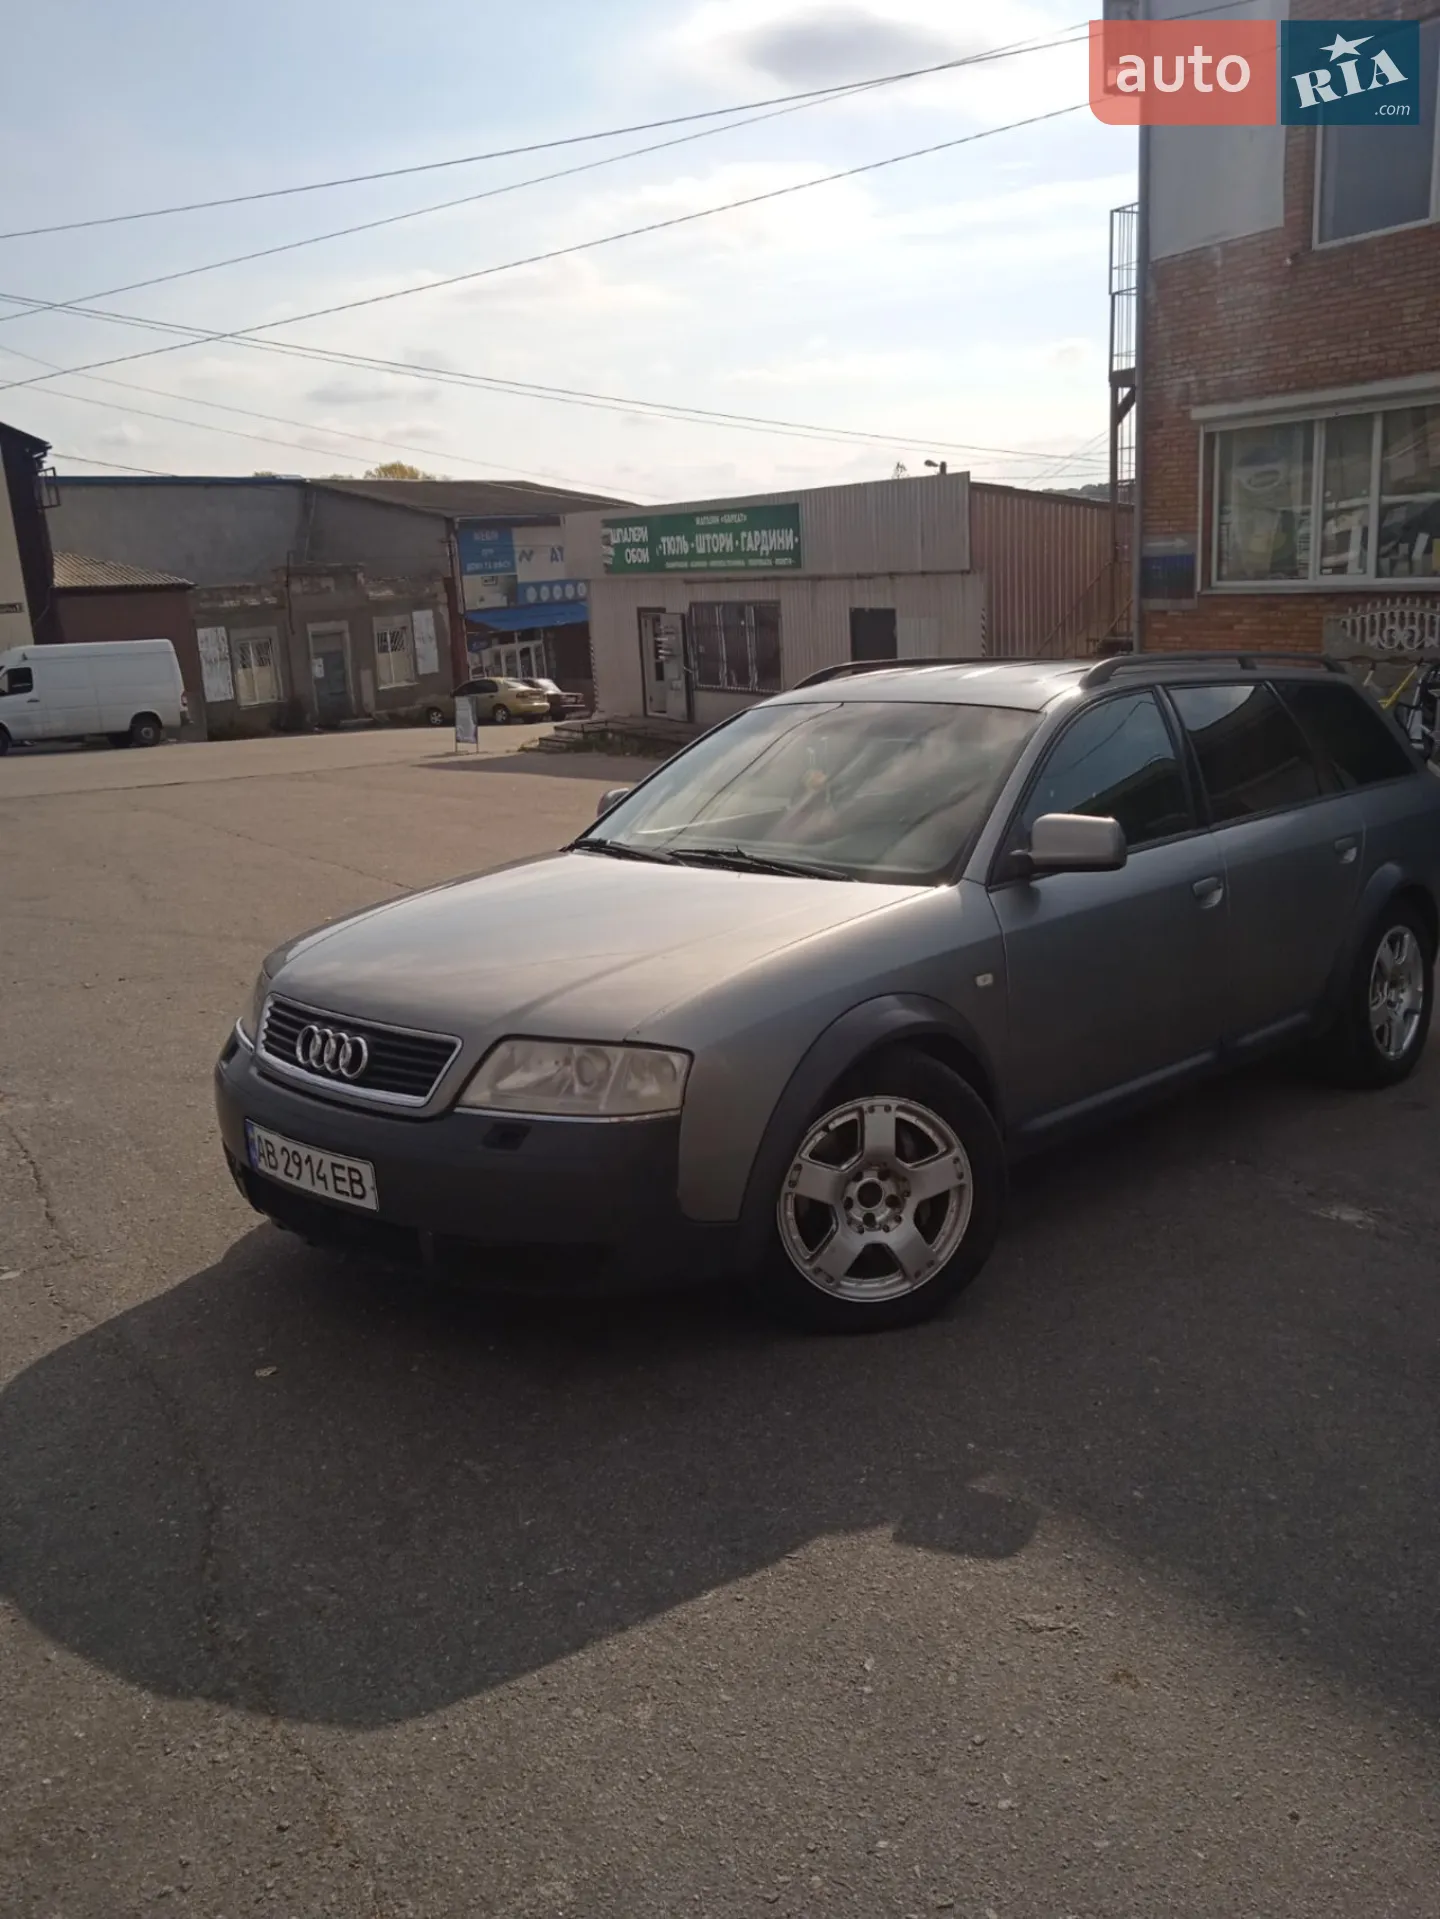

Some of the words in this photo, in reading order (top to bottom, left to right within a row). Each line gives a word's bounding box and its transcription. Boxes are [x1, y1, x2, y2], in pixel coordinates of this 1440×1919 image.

[610, 526, 649, 545] ШПАЛЕРИ
[660, 534, 690, 556] ТЮЛЬ
[695, 532, 734, 554] ШТОРИ
[740, 528, 794, 556] ГАРДИНИ
[625, 546, 650, 564] ОБОИ
[257, 1134, 278, 1171] AB
[280, 1146, 329, 1192] 2914
[330, 1162, 366, 1200] EB
